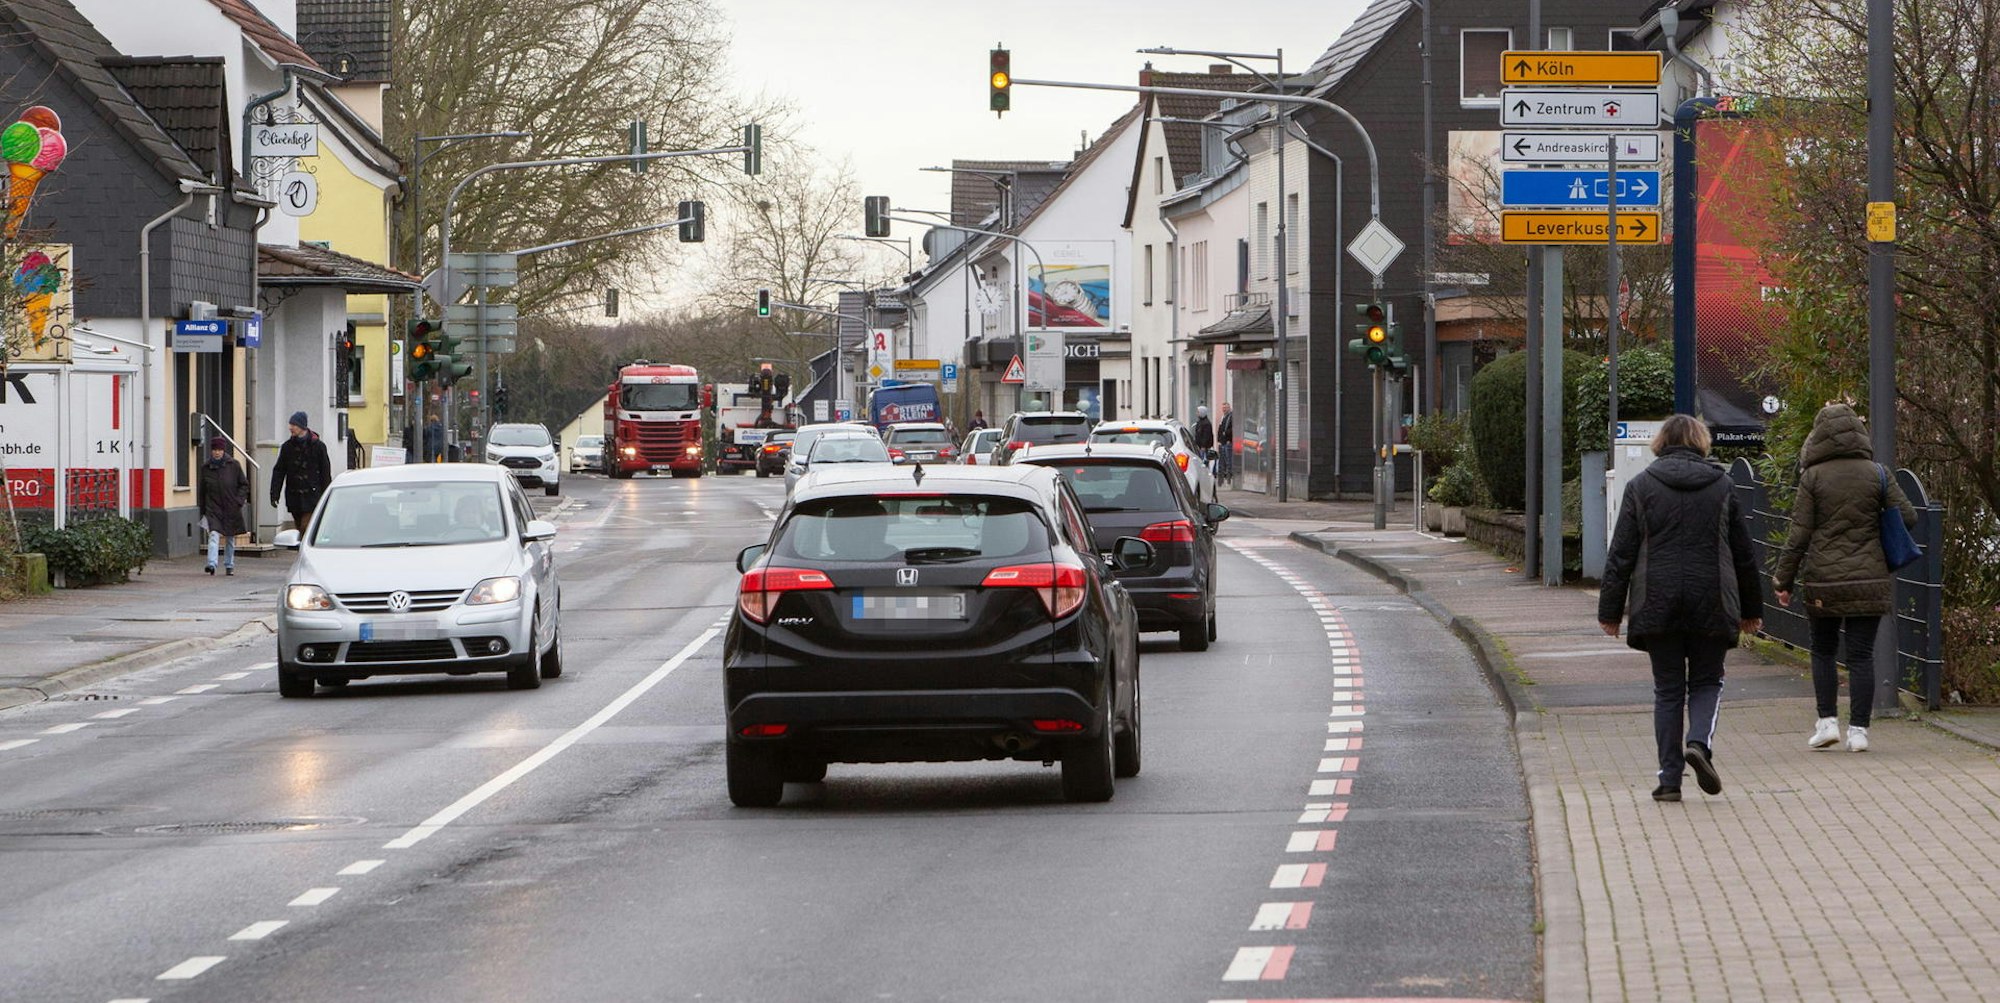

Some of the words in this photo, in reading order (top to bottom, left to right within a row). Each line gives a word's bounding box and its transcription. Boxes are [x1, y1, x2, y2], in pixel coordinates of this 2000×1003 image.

[1537, 61, 1574, 76] Köln
[1536, 102, 1596, 115] Zentrum
[257, 129, 312, 150] Olivenhof
[1536, 142, 1618, 153] Andreaskirch
[1526, 220, 1624, 235] Leverkusen
[900, 403, 934, 412] STEFAN
[900, 409, 928, 420] KLEIN
